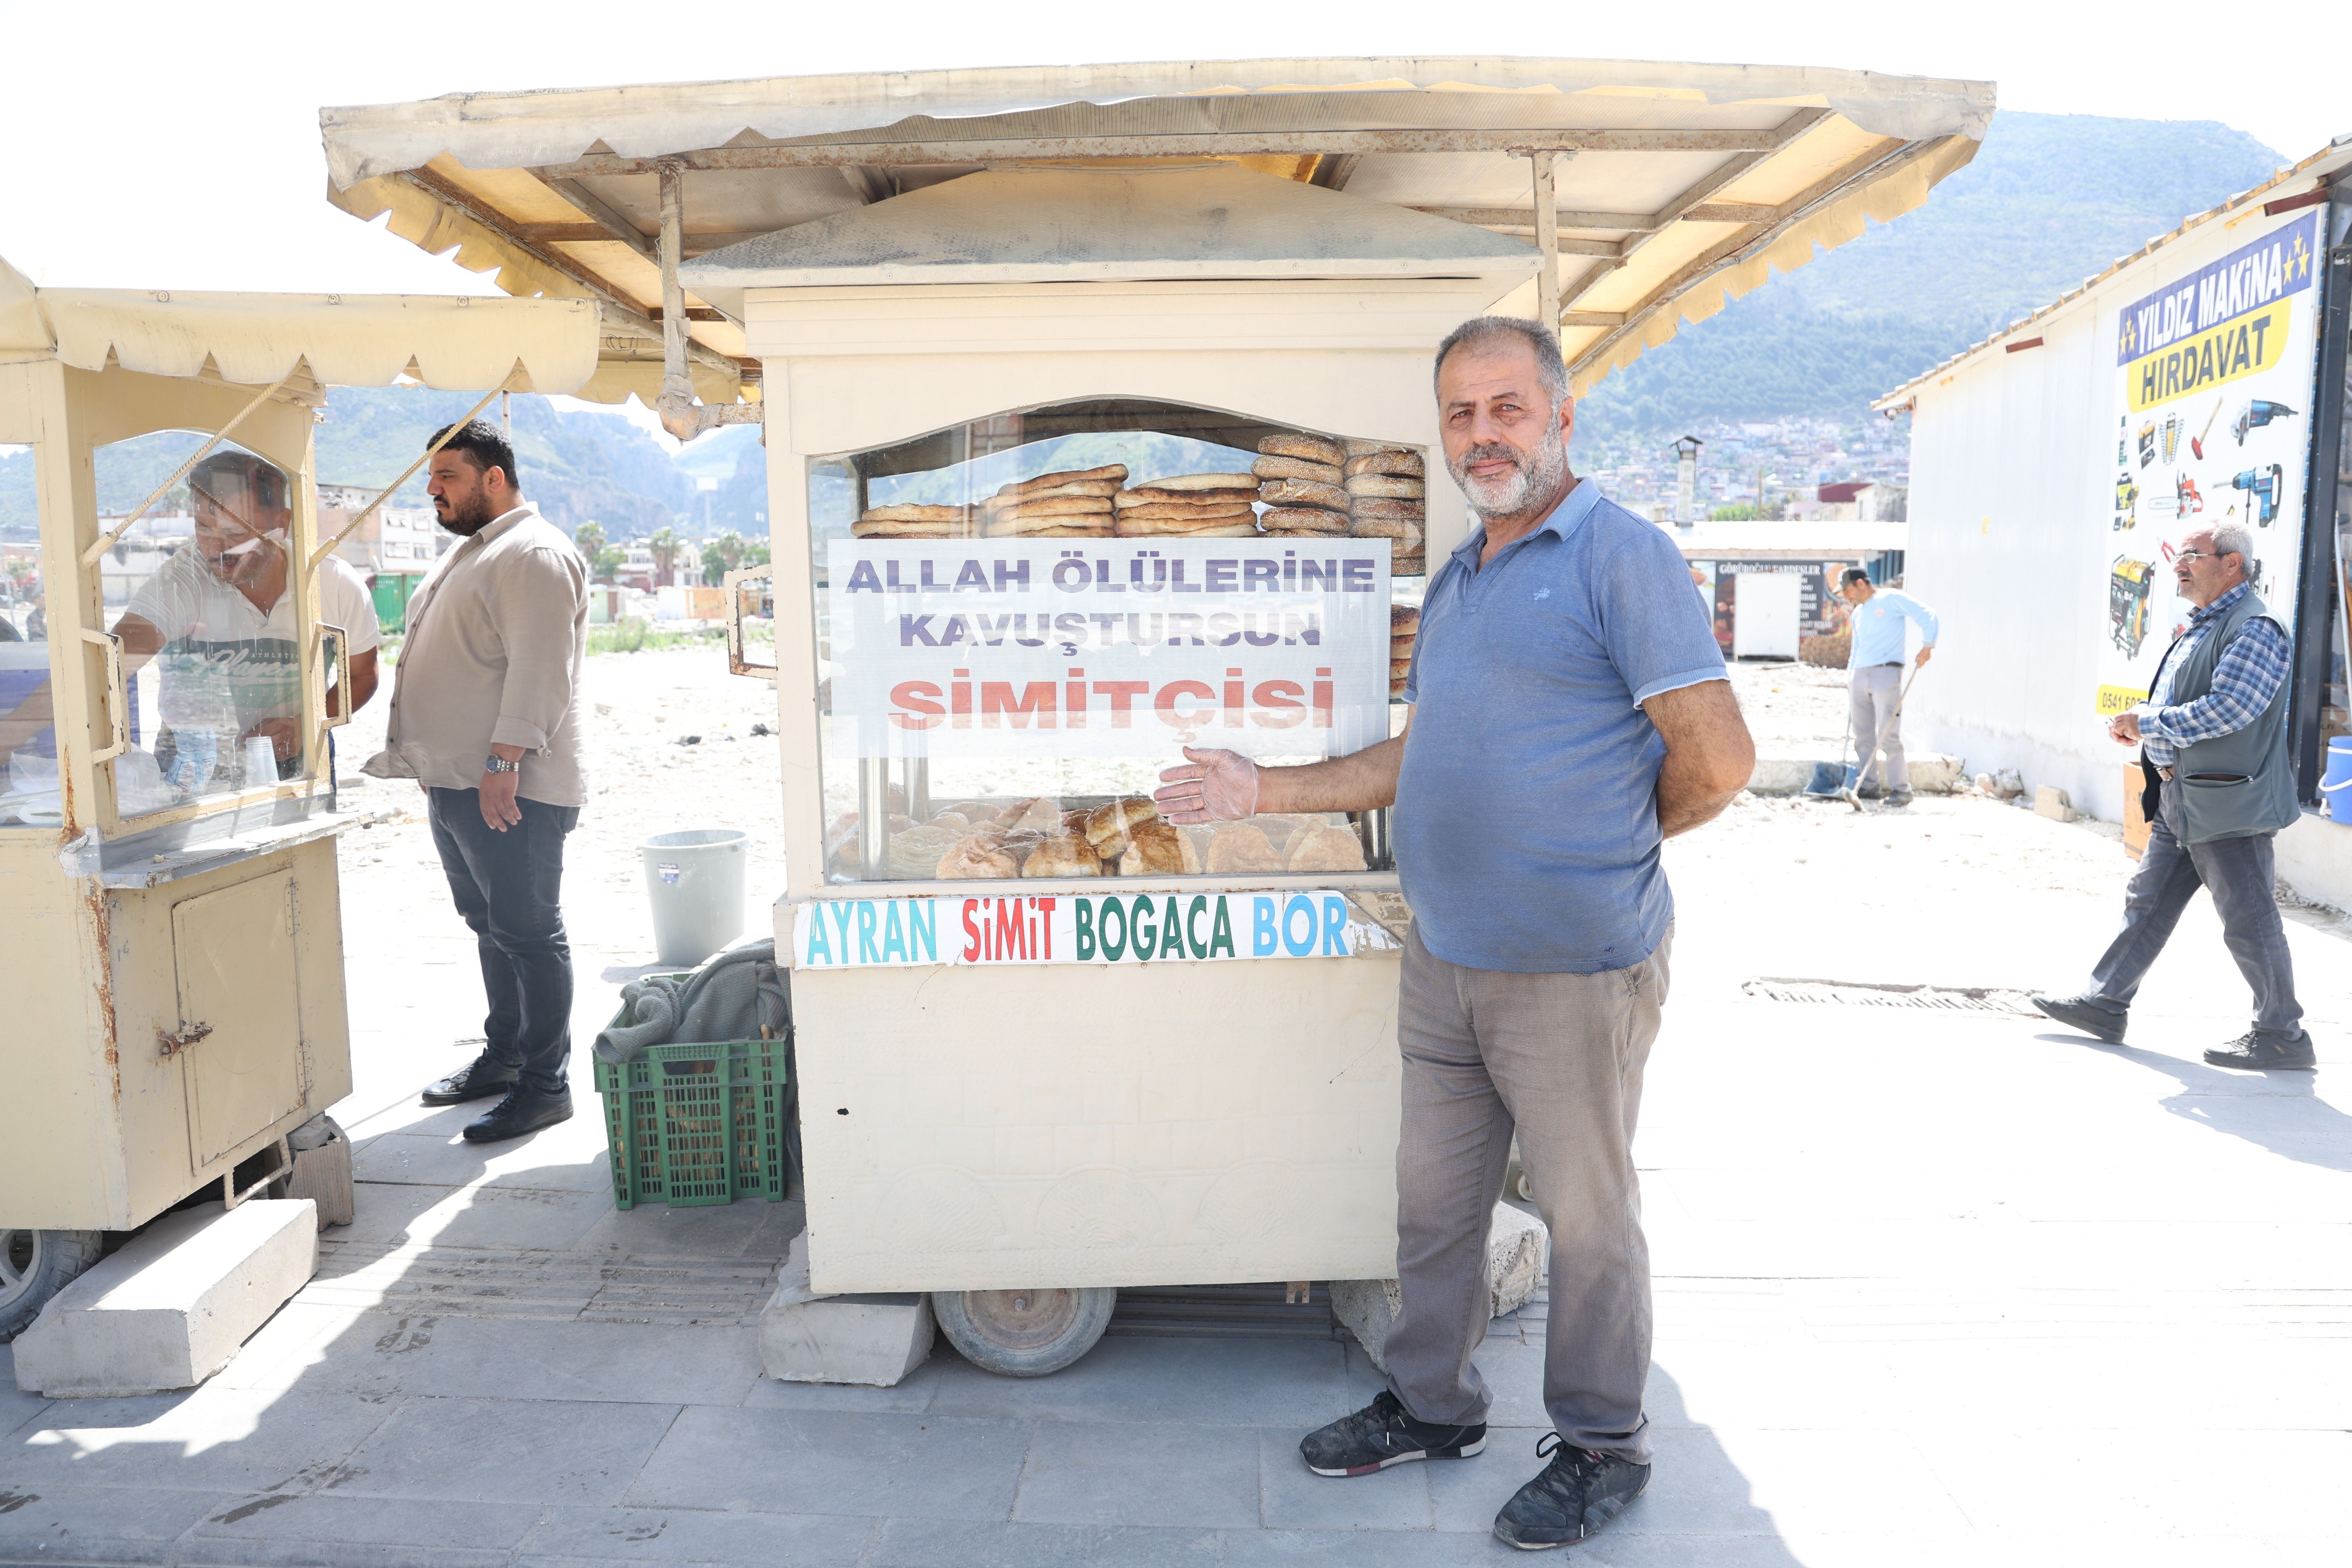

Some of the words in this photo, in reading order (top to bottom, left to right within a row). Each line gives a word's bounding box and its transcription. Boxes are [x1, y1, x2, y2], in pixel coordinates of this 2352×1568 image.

[2138, 284, 2195, 354] YILDIZ
[2141, 314, 2272, 405] HIRDAVAT
[845, 559, 1030, 593] ALLAH
[1053, 550, 1375, 593] ÖLÜLERİNE
[900, 612, 1320, 656] KAVUŞTURSUN
[888, 667, 1334, 743] SİMİTÇİSİ
[2103, 693, 2122, 710] 0541
[2125, 696, 2141, 711] 60
[807, 899, 937, 965] AYRAN
[1253, 891, 1355, 957] BÖR
